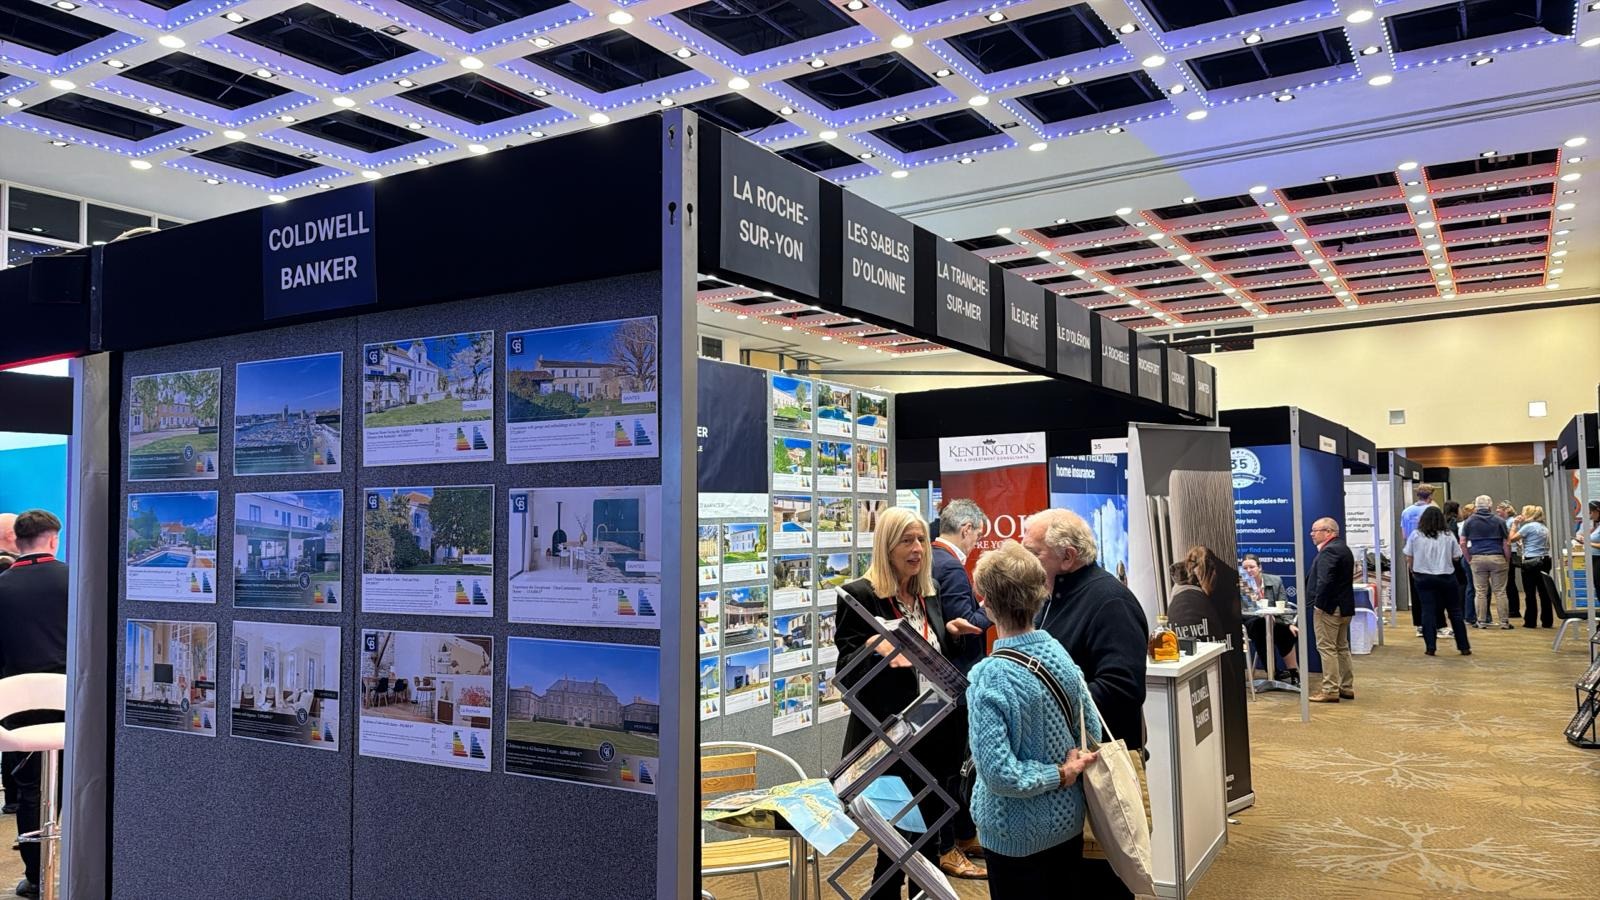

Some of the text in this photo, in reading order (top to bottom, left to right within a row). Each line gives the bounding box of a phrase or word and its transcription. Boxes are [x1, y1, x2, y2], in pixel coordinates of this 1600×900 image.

[732, 175, 809, 225] LA ROCHE-
[268, 210, 370, 251] COLDWELL
[739, 219, 804, 262] SUR-YON
[847, 220, 910, 263] LES SABLES
[281, 256, 358, 290] BANKER
[852, 257, 906, 294] D'OLONNE
[937, 260, 989, 296] LA TRANCHE-
[946, 294, 982, 322] SUR-MER
[1011, 302, 1039, 331] ÎLE DE RÉ
[949, 443, 1036, 458] KENTINGTONS
[1231, 458, 1248, 470] 35
[1056, 464, 1096, 479] home insurance
[1254, 498, 1276, 506] policies
[1190, 618, 1209, 637] well
